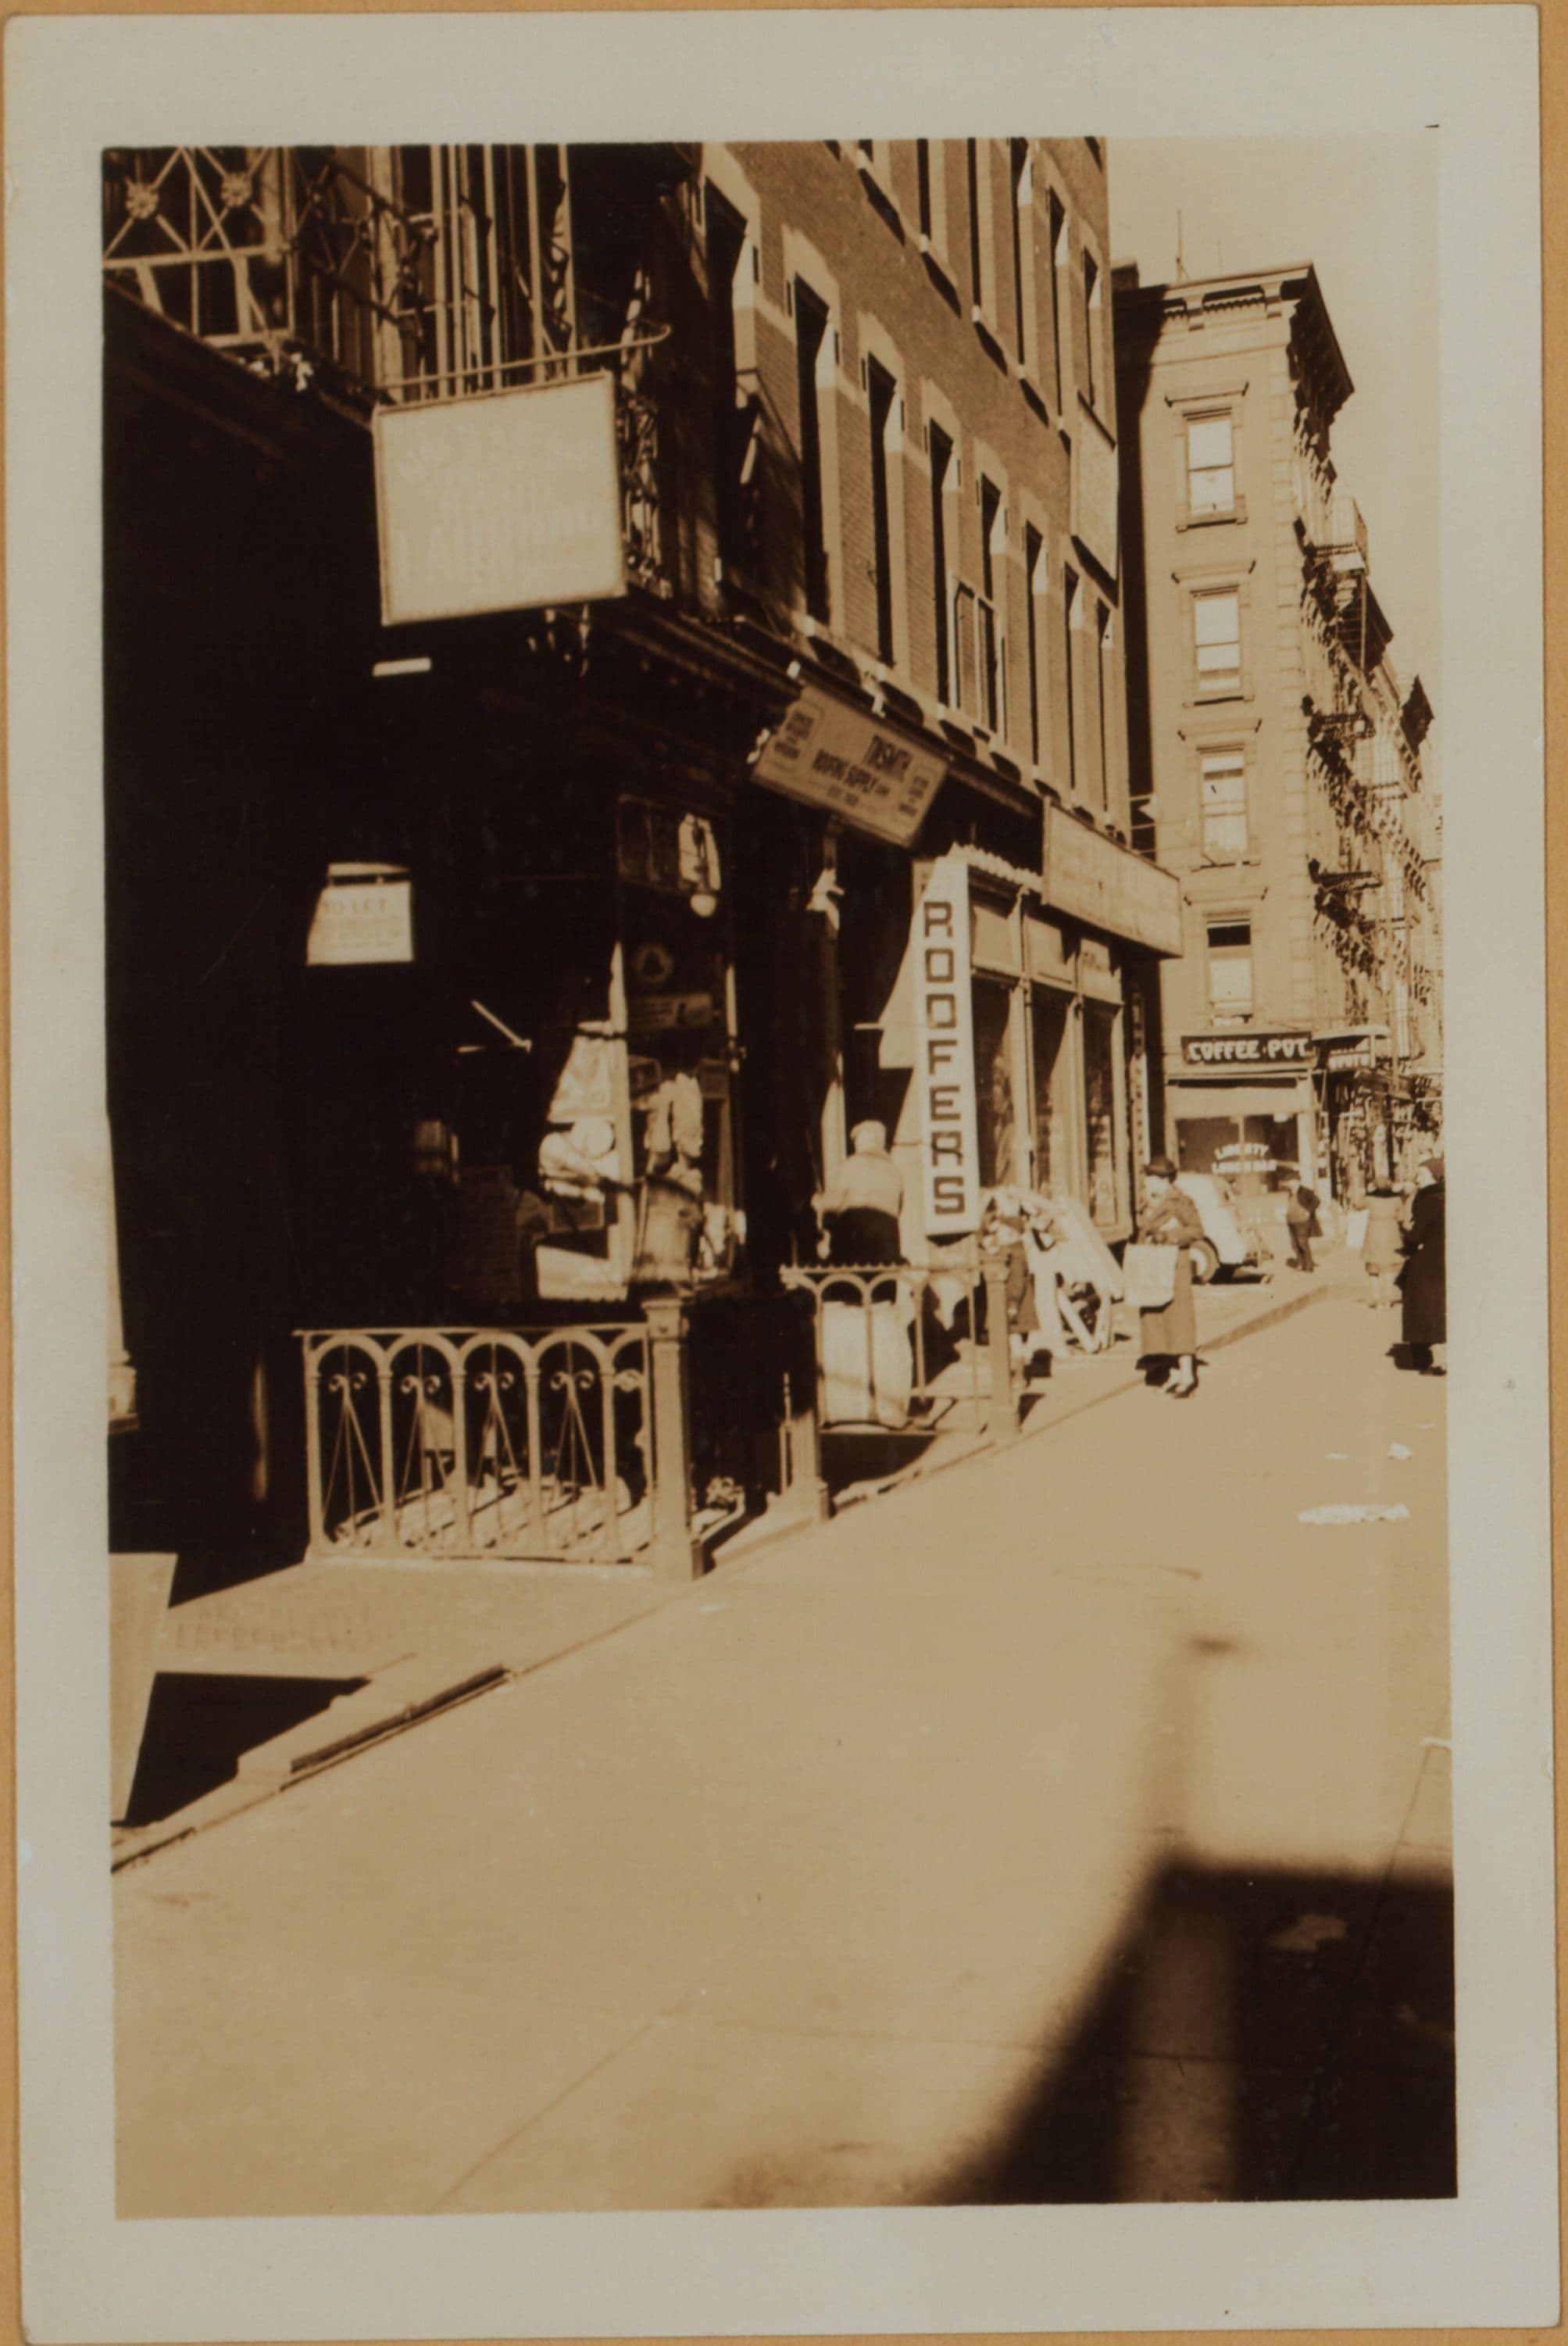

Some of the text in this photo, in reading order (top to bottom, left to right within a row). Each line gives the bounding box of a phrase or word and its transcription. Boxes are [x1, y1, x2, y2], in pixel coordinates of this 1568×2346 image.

[923, 900, 966, 1215] ROOFERS
[1188, 1038, 1309, 1060] COFFEE POT
